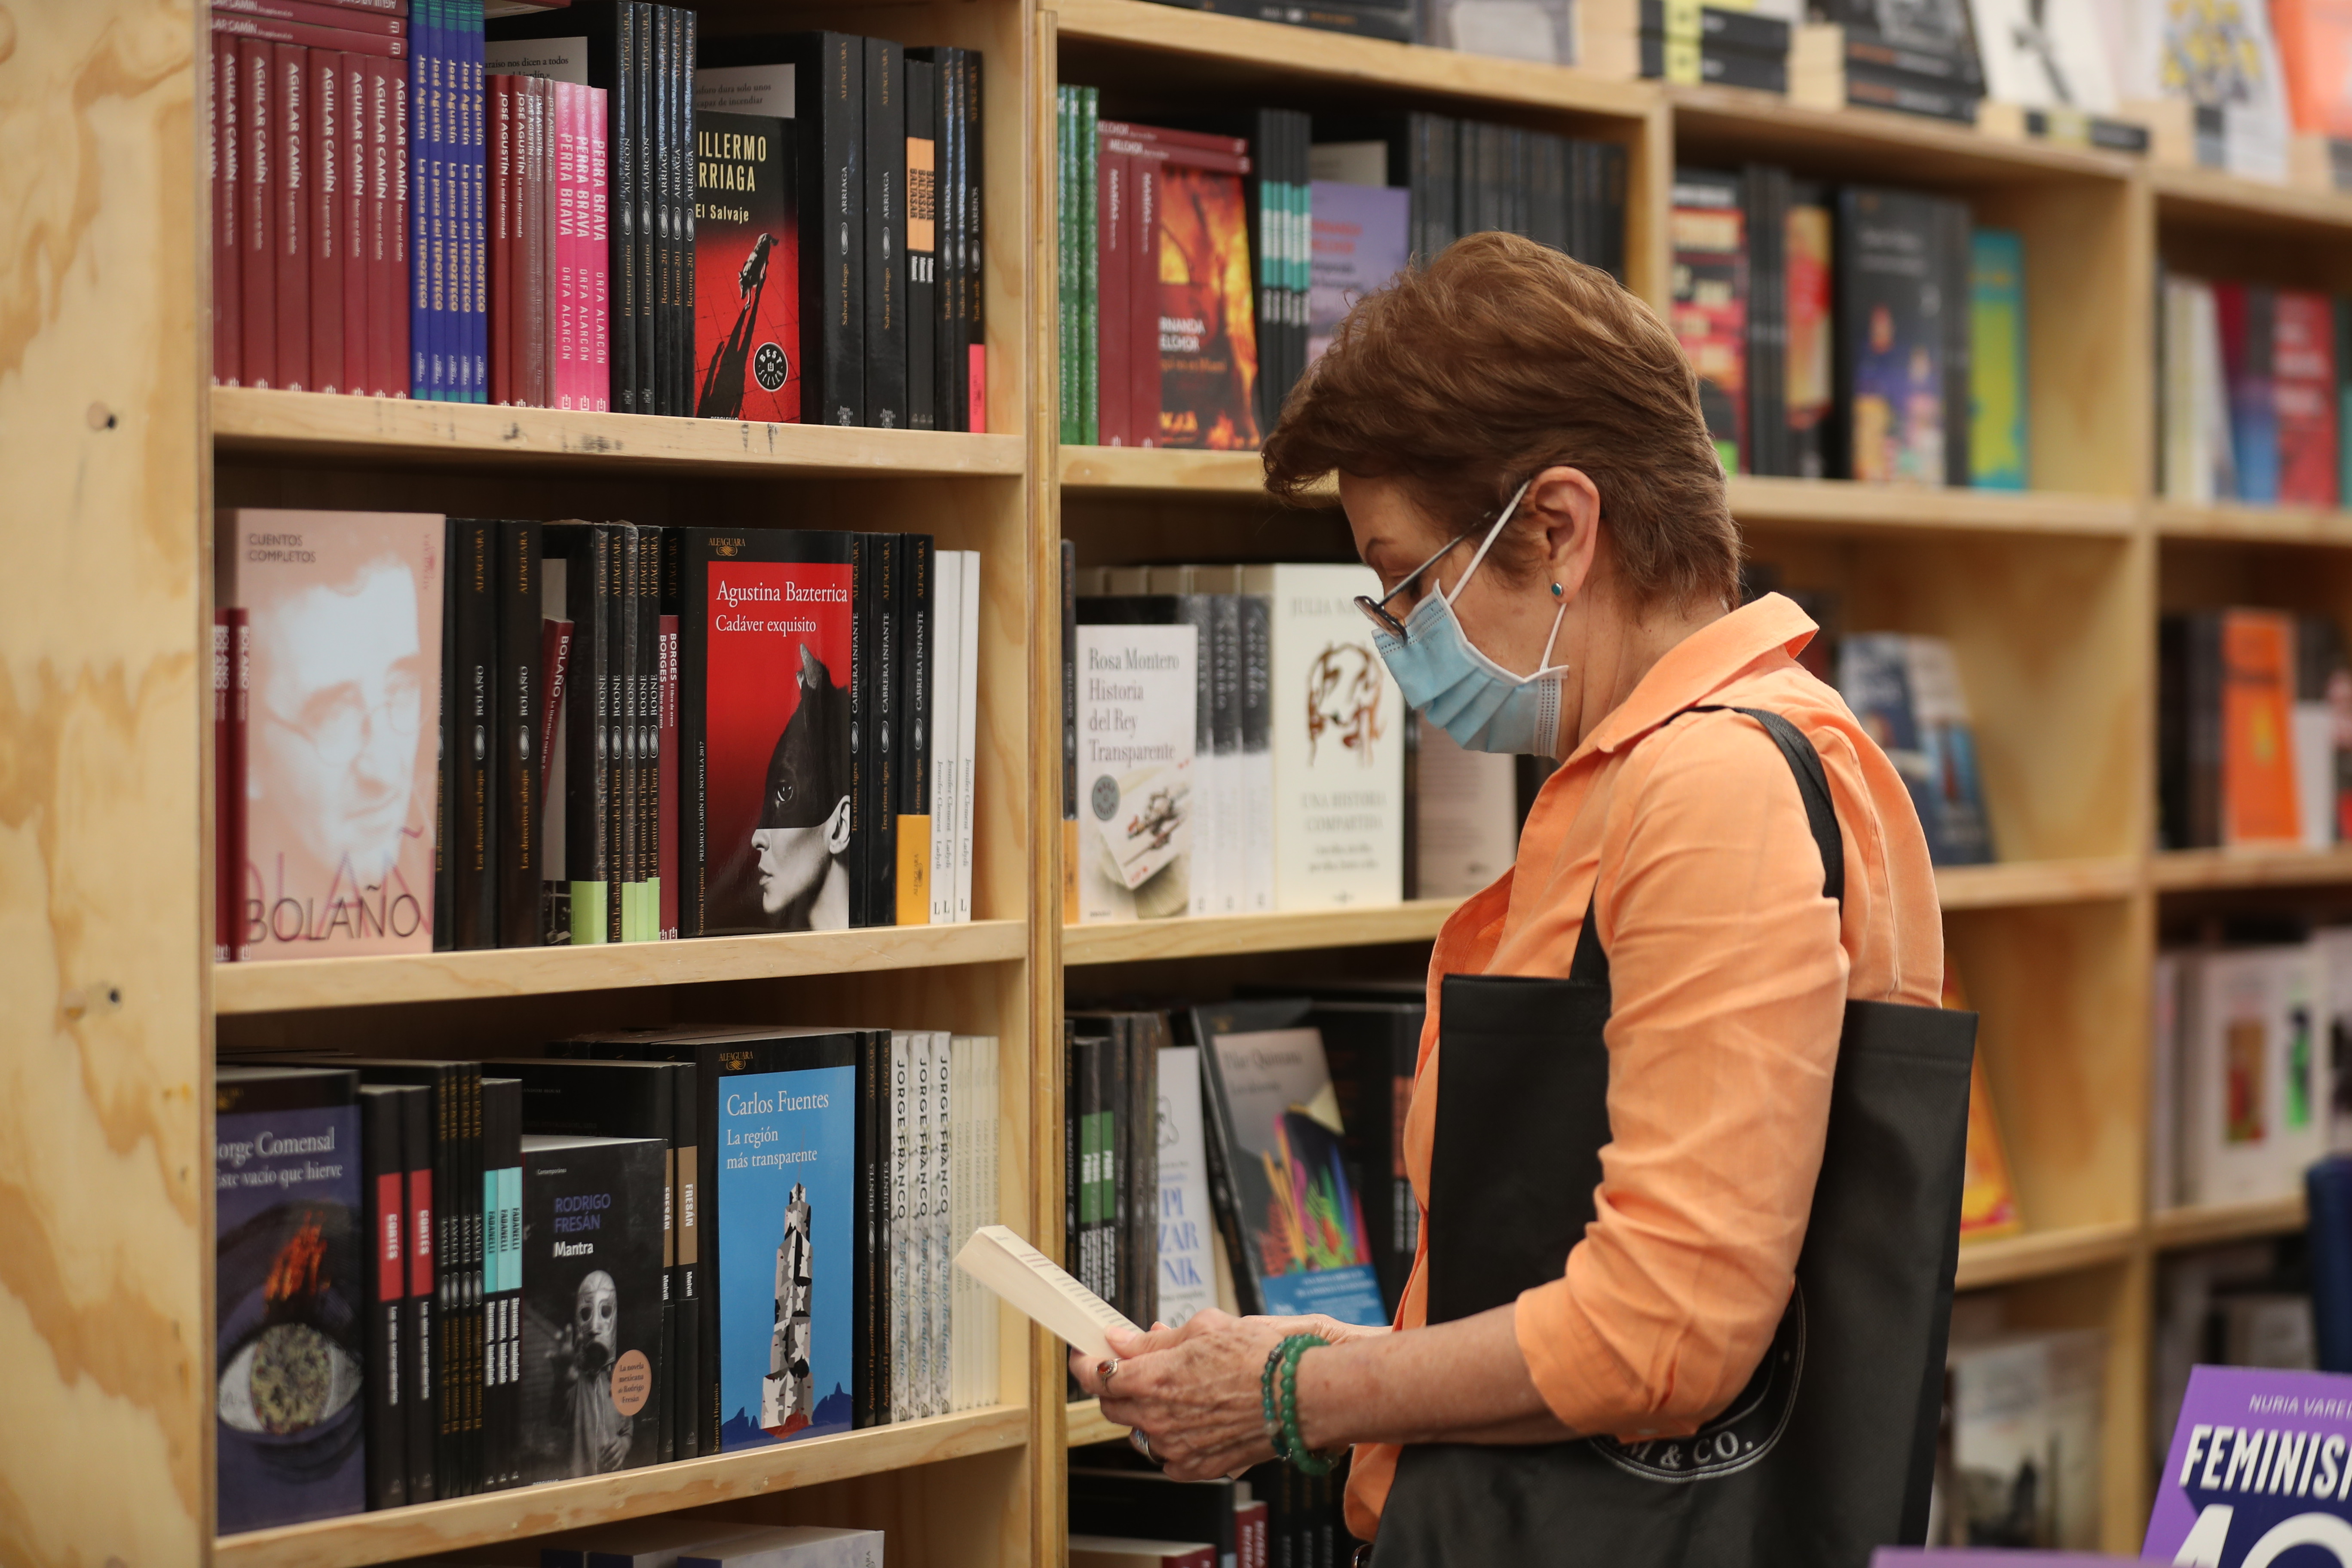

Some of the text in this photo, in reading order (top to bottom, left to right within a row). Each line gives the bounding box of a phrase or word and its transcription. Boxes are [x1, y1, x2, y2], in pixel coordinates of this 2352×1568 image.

[416, 55, 426, 83] José
[522, 58, 541, 66] dicen
[549, 56, 568, 64] todos
[474, 62, 483, 91] José
[737, 83, 751, 91] solo
[288, 63, 300, 132] AGUILAR
[323, 67, 334, 136] AGUILAR
[500, 92, 508, 120] JOSÉ
[396, 78, 406, 146] AGUILAR
[352, 72, 364, 195] AGUILAR CAMÍN
[376, 76, 387, 199] AGUILAR CAMÍN
[517, 92, 526, 174] JOSÉ AGUSTÍN
[699, 131, 766, 162] ILLERMO
[501, 124, 510, 175] AGUSTÍN
[397, 150, 407, 200] CAMÍN
[478, 165, 483, 179] La
[560, 134, 573, 236] PERRA BRAVA
[696, 162, 756, 192] RRIAGA
[576, 137, 590, 238] PERRA BRAVA
[591, 141, 606, 241] PERRA BRAVA
[696, 203, 749, 223] El Salvaje
[399, 225, 402, 233] en
[475, 242, 485, 313] TEPOZTECO
[625, 308, 631, 316] El
[562, 304, 572, 359] ALARCÓN
[580, 306, 589, 361] ALARCÓN
[596, 309, 606, 364] ALARCÓN
[760, 349, 782, 364] BEST
[759, 370, 783, 386] SELLER
[249, 533, 303, 546] CUENTOS
[709, 537, 746, 547] ALFAGUARA
[249, 551, 316, 564] COMPLETOS
[716, 580, 847, 607] Agustina Bazterrica
[716, 614, 816, 637] Cadáver exquisito
[553, 636, 569, 698] BOLAÑO
[1088, 647, 1180, 672] Rosa Montero
[1088, 679, 1145, 703] Historia
[1089, 709, 1111, 732] del
[1089, 739, 1176, 768] Transparente
[699, 790, 704, 801] DE
[613, 810, 620, 820] de
[247, 883, 420, 943] BOLAÑO
[719, 1050, 753, 1061] ALFAGUARA
[726, 1090, 829, 1117] Carlos Fuentes
[258, 1126, 336, 1158] Comensal
[727, 1129, 778, 1149] La región
[897, 1060, 906, 1220] JORGE FRANCO
[940, 1056, 949, 1213] JORGE FRANCO
[727, 1148, 817, 1170] más transparente
[280, 1169, 304, 1190] que
[555, 1193, 611, 1213] RODRIGO
[685, 1184, 693, 1227] FRESÁN
[555, 1212, 601, 1232] FRESÁN
[553, 1241, 594, 1258] Mantra
[619, 1374, 643, 1382] mexicana
[628, 1362, 644, 1370] novela
[622, 1395, 639, 1403] Fresán
[2248, 1393, 2299, 1415] NURIA
[1660, 1444, 1682, 1470] &
[1693, 1431, 1753, 1464] CO.
